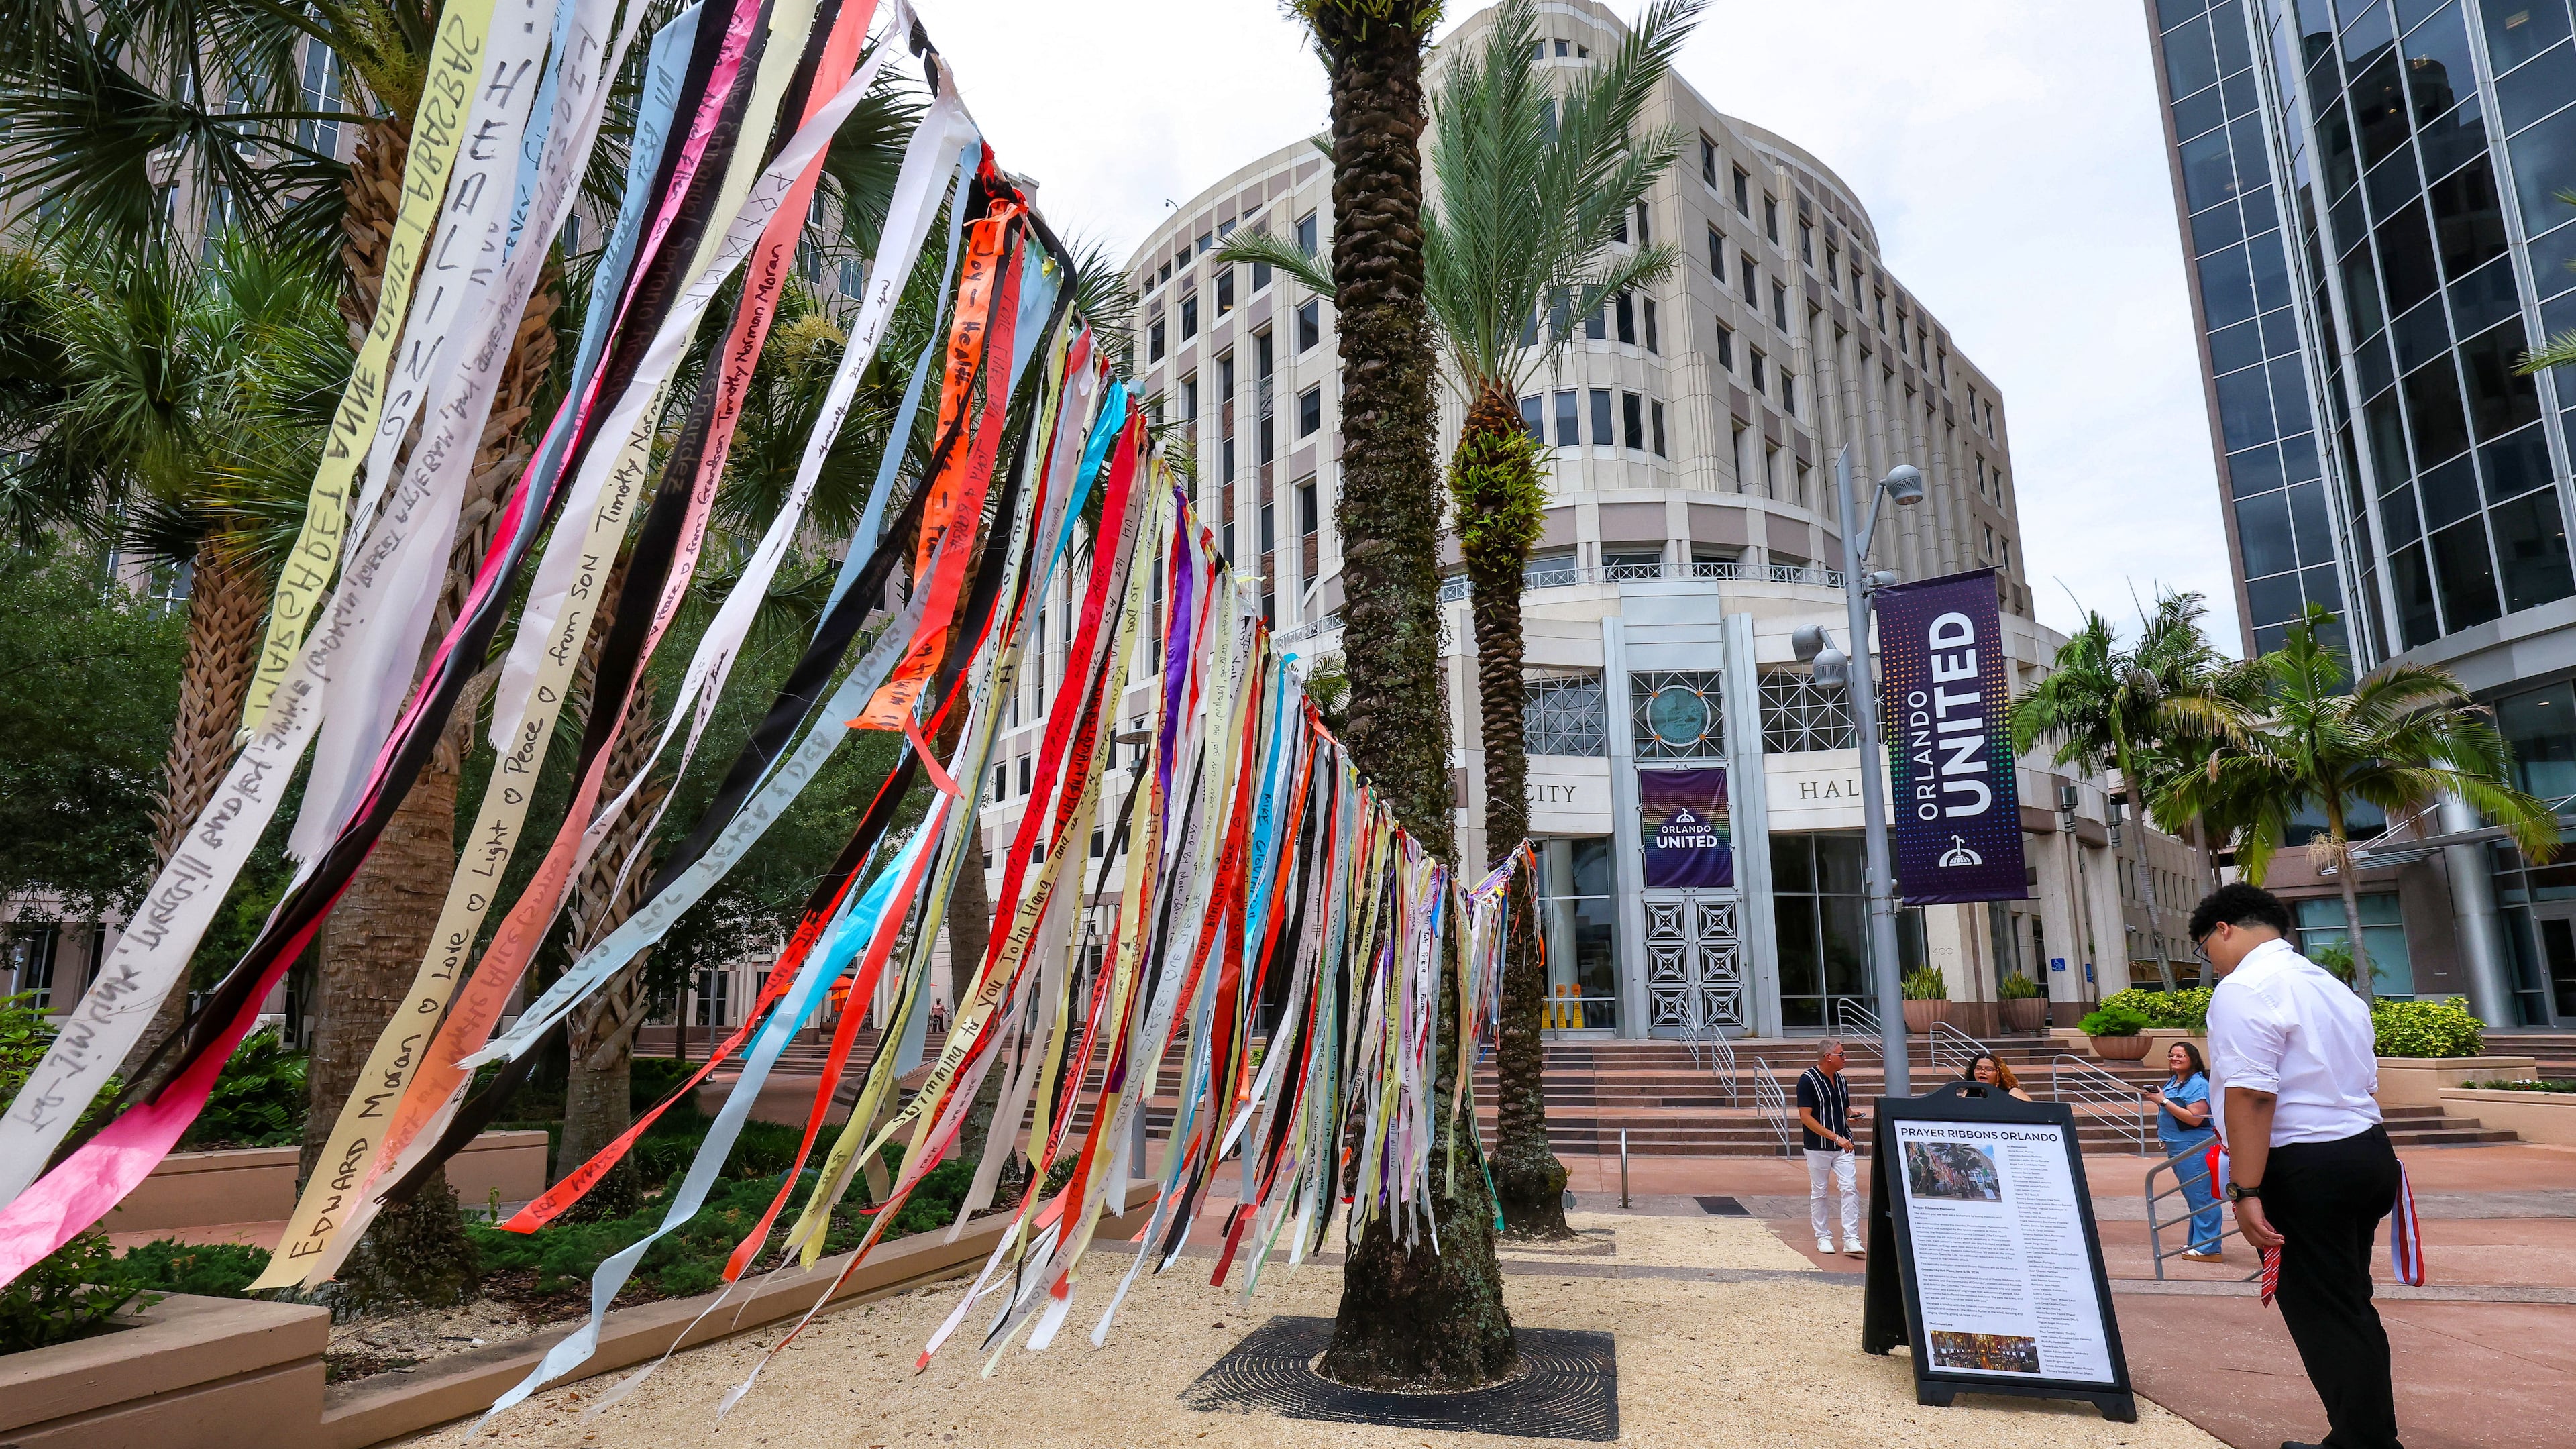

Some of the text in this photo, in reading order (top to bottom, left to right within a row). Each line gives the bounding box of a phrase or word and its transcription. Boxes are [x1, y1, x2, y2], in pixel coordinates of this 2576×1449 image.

[682, 511, 704, 556] from
[695, 432, 726, 506] Grandson
[711, 362, 751, 432] Timothy
[733, 303, 764, 364] Norman
[756, 241, 785, 304] Moran
[1928, 612, 1992, 818] UNITED
[1907, 690, 1938, 820] ORLANDO
[1799, 778, 1860, 800] HAL
[287, 376, 669, 1271] EDWARD Moran Love Light Peace from SON Timothy Norman
[1258, 793, 1273, 827] MIKE
[1656, 835, 1717, 848] UNITED
[1661, 825, 1711, 833] ORLANDO
[996, 921, 1030, 969] John
[1932, 947, 1953, 956] 400
[1900, 1128, 2057, 1142] PRAYER RIBBONS ORLANDO
